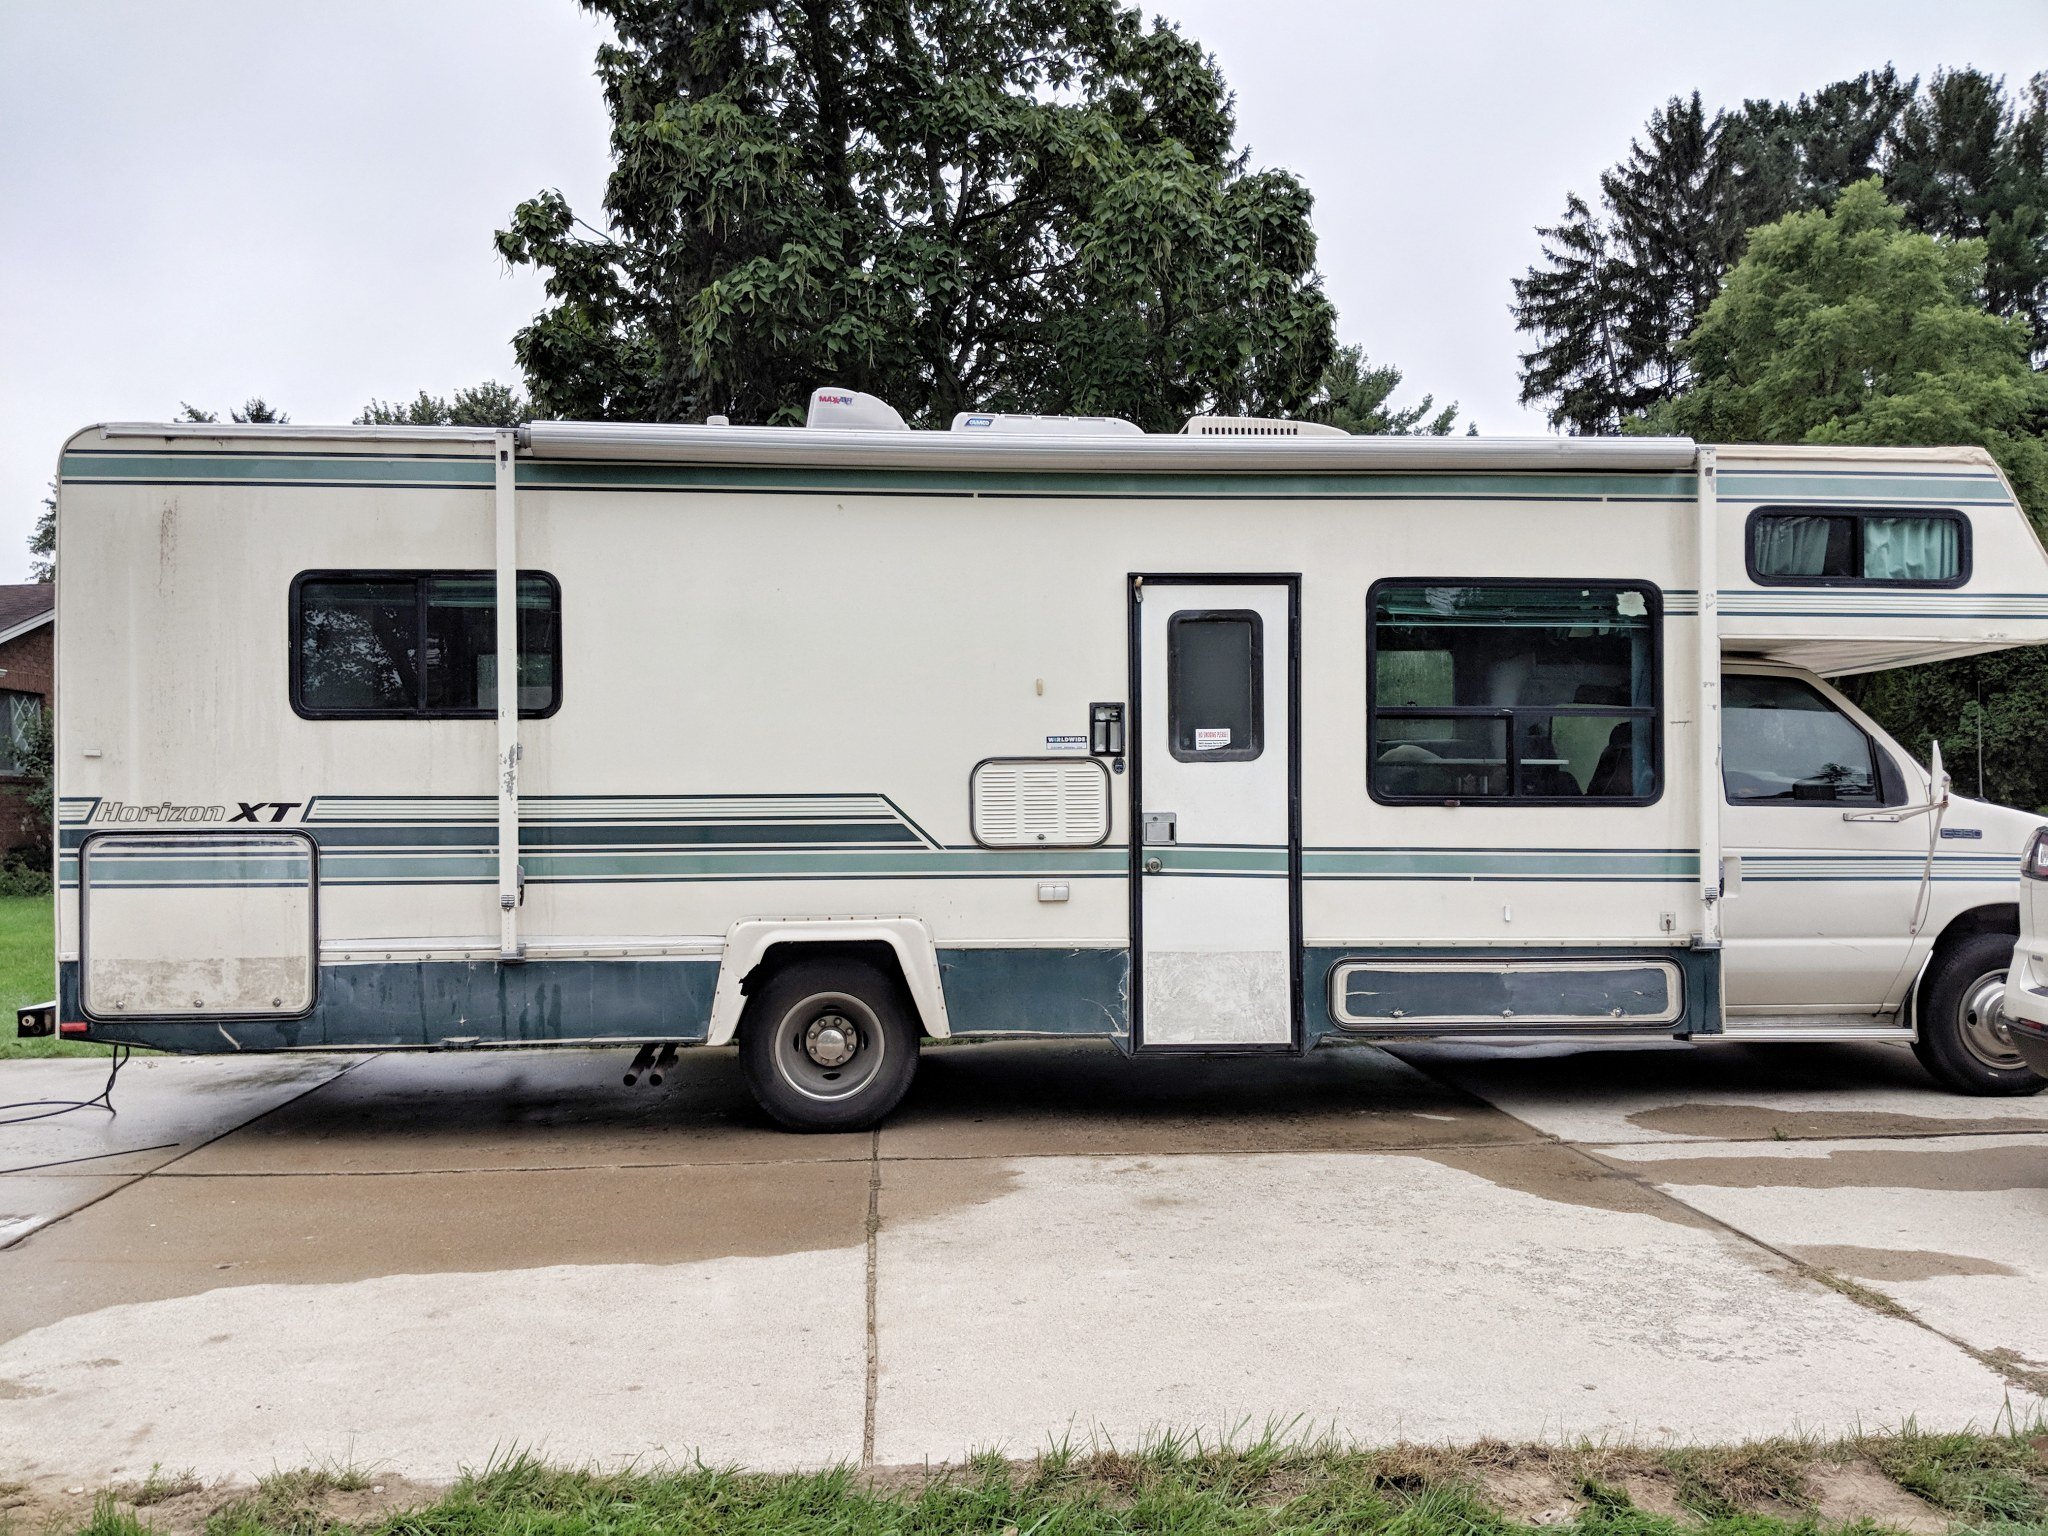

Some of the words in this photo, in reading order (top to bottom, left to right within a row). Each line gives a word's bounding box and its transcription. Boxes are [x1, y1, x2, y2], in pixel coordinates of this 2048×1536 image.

[94, 801, 226, 823] Horizon
[226, 802, 303, 823] XT
[1941, 828, 1982, 839] E350
